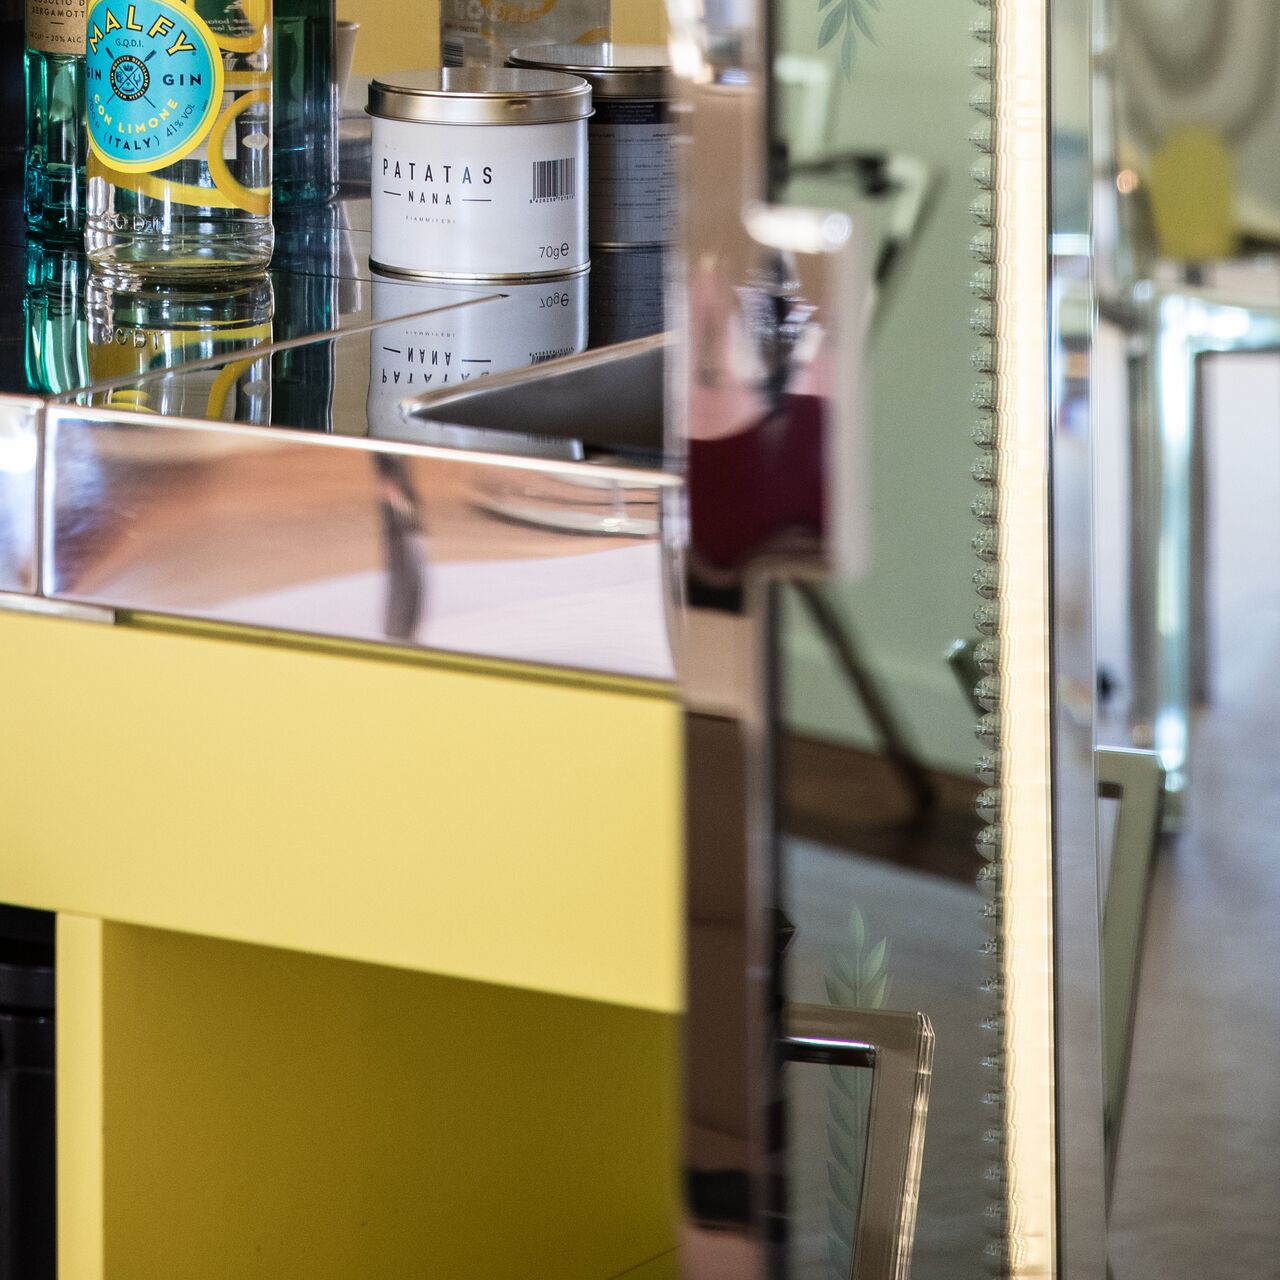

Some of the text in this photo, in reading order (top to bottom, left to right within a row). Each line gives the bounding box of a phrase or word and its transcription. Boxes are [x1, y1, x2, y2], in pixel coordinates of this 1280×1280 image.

[88, 4, 197, 57] MALFY
[115, 38, 144, 48] G.Q.D.I.
[162, 73, 202, 86] GIN
[94, 93, 112, 125] CON
[117, 98, 178, 136] LIMONE
[166, 103, 196, 137] 41% VOL
[103, 132, 160, 151] (ITALY)
[383, 158, 492, 184] PATATAS
[408, 191, 451, 206] NANA
